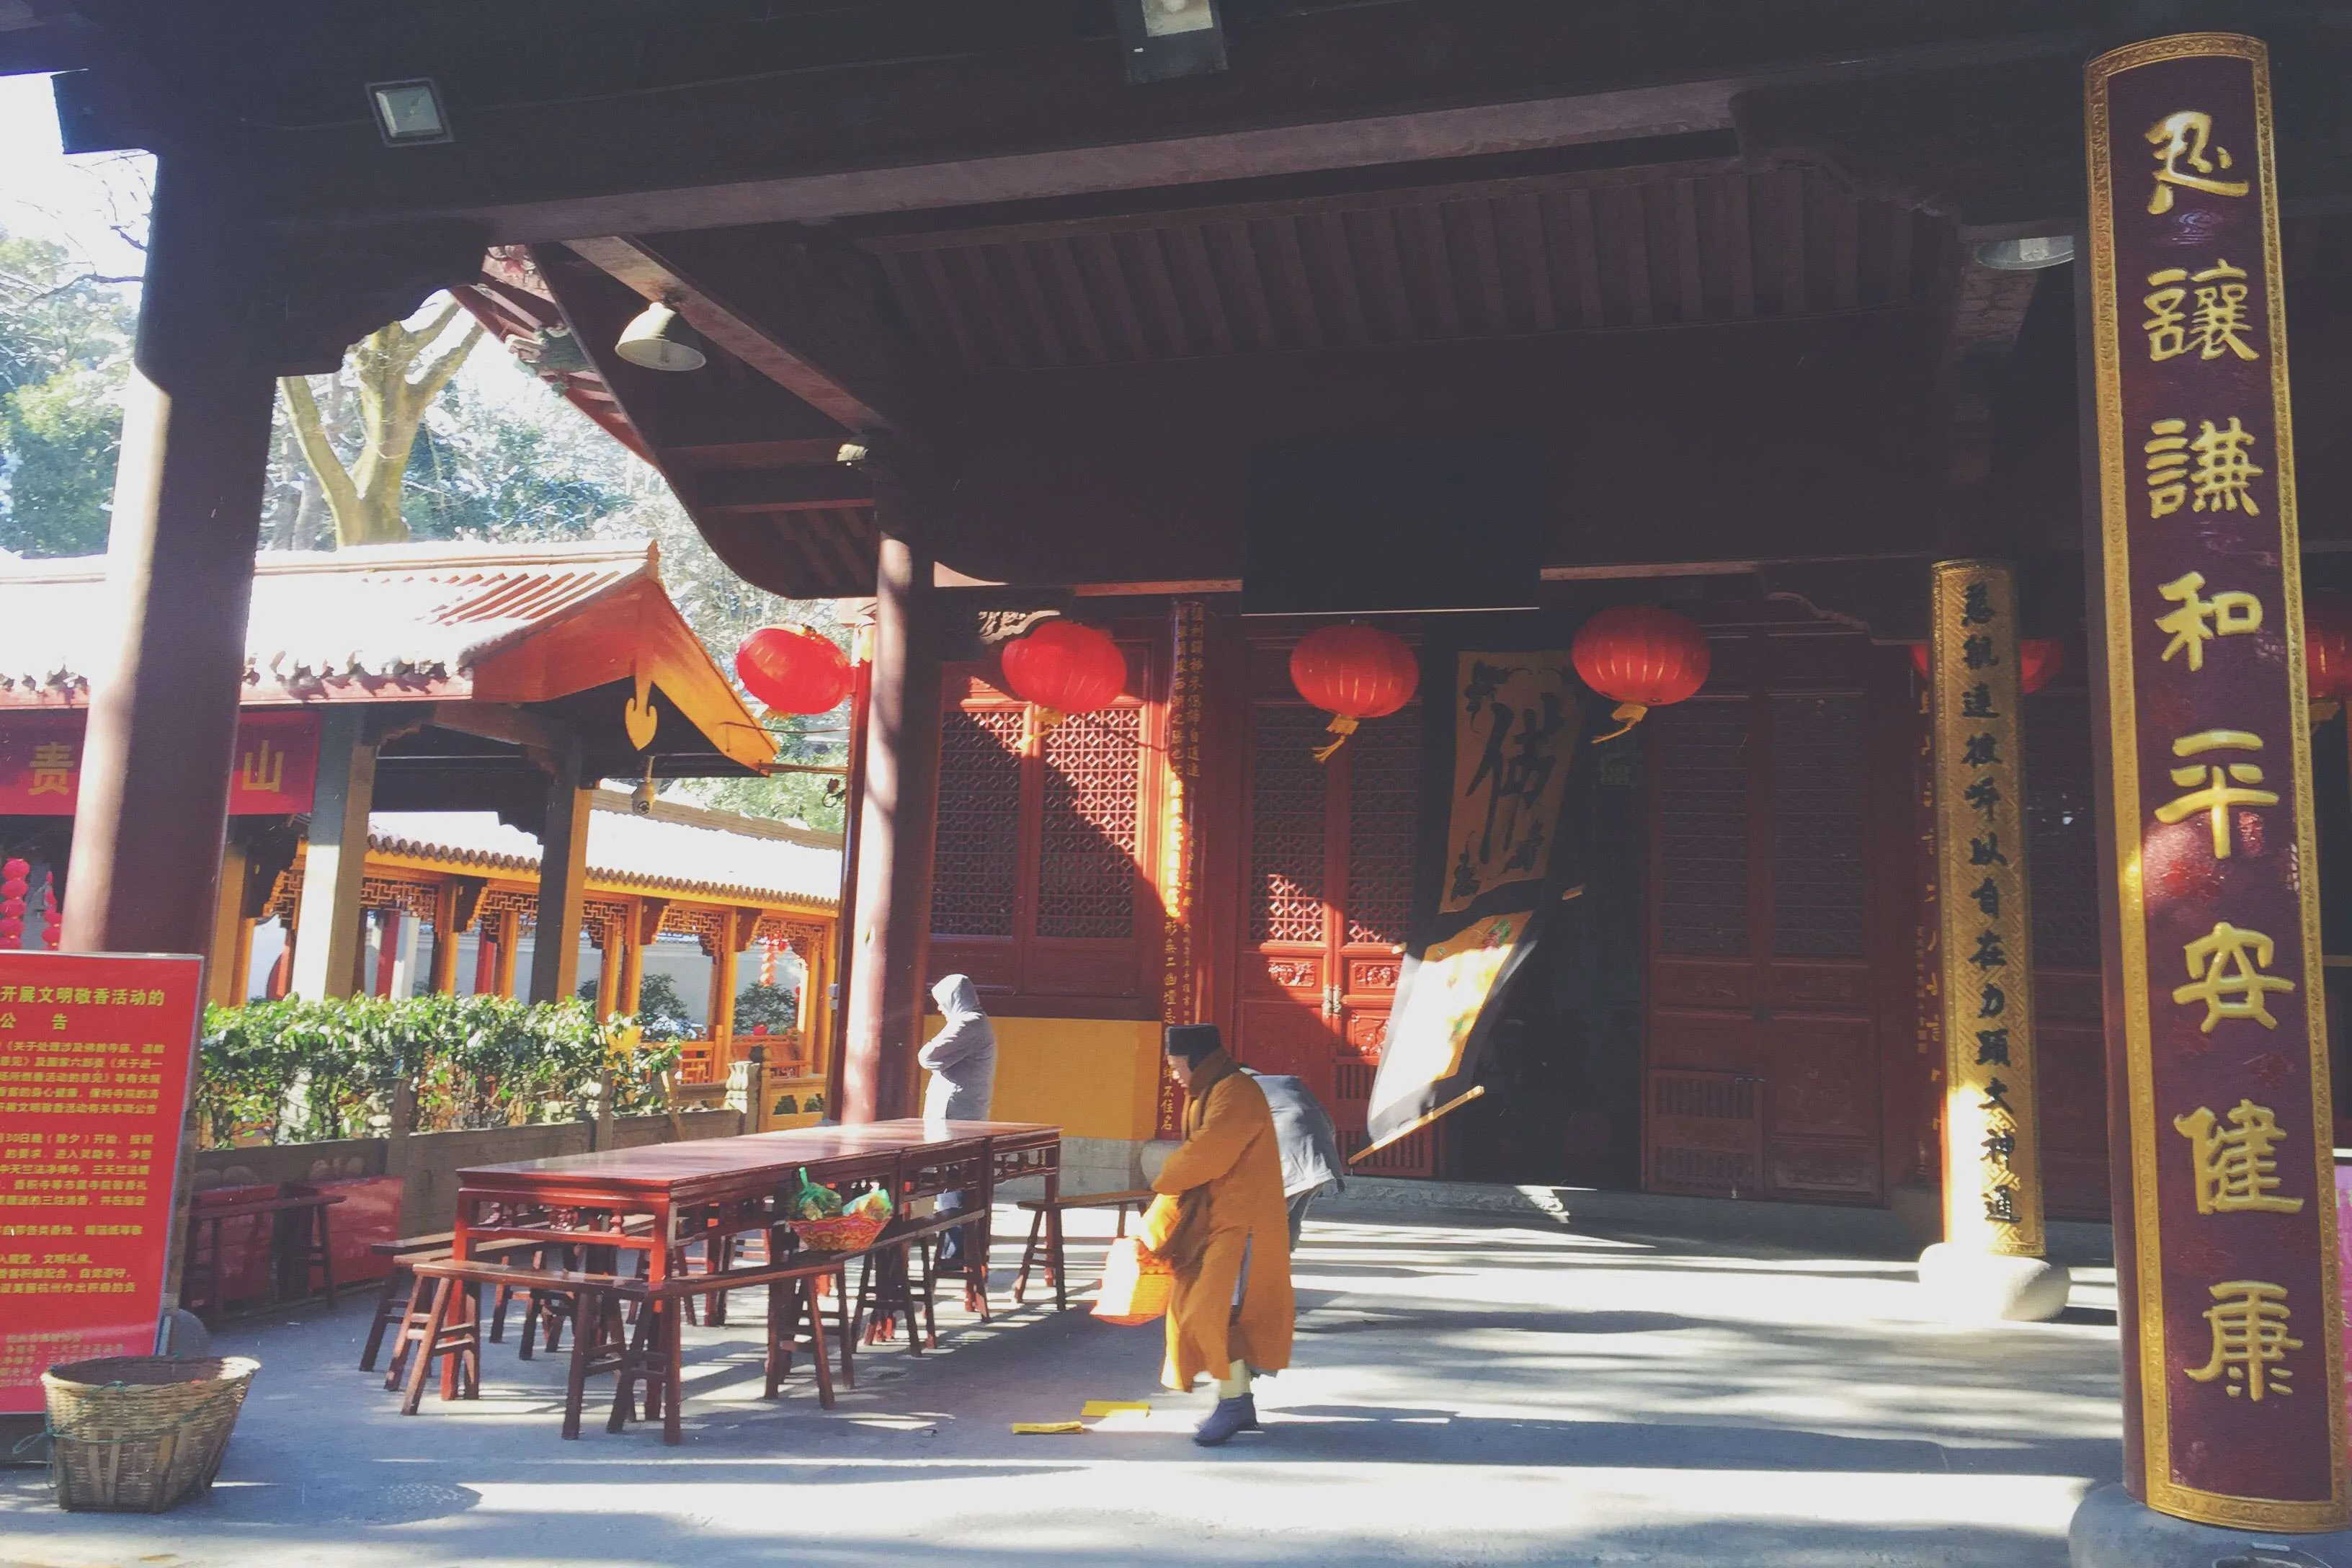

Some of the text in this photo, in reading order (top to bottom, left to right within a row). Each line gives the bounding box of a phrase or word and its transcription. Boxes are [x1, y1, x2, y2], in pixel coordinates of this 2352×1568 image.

[27, 739, 284, 796] 责 山
[2143, 110, 2305, 1402] 忍讓謙和平安健康
